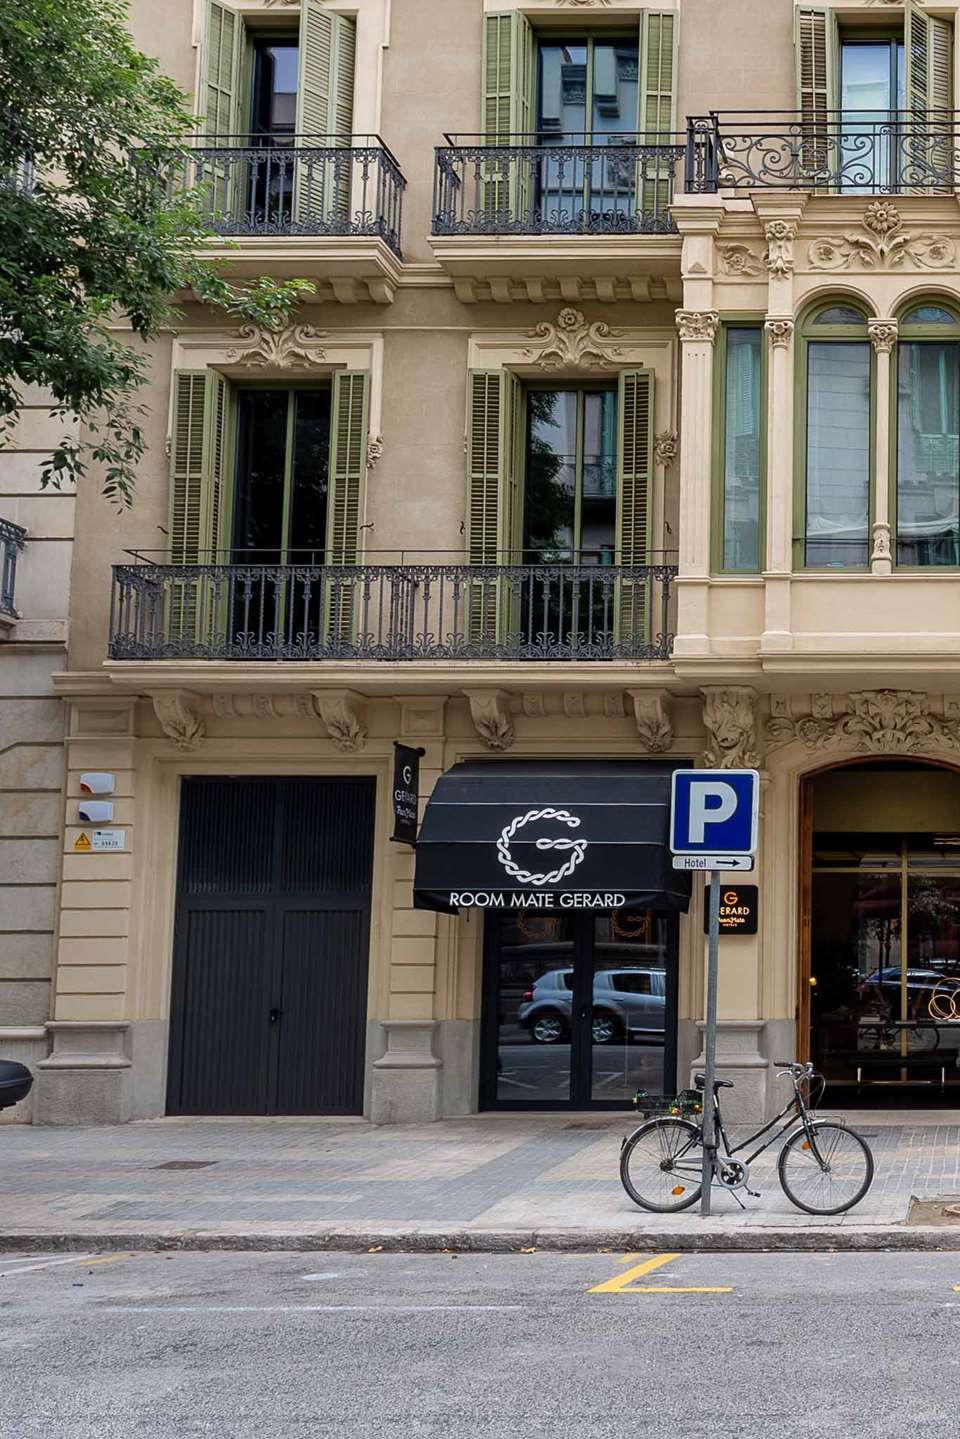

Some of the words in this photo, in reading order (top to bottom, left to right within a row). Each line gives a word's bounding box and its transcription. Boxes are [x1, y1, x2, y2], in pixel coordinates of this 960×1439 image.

[688, 781, 738, 844] P
[684, 858, 707, 868] Hotel
[449, 892, 505, 907] ROOM
[510, 893, 554, 908] MATE
[559, 893, 626, 908] GERARD
[724, 891, 738, 905] G
[719, 906, 750, 915] ERARD
